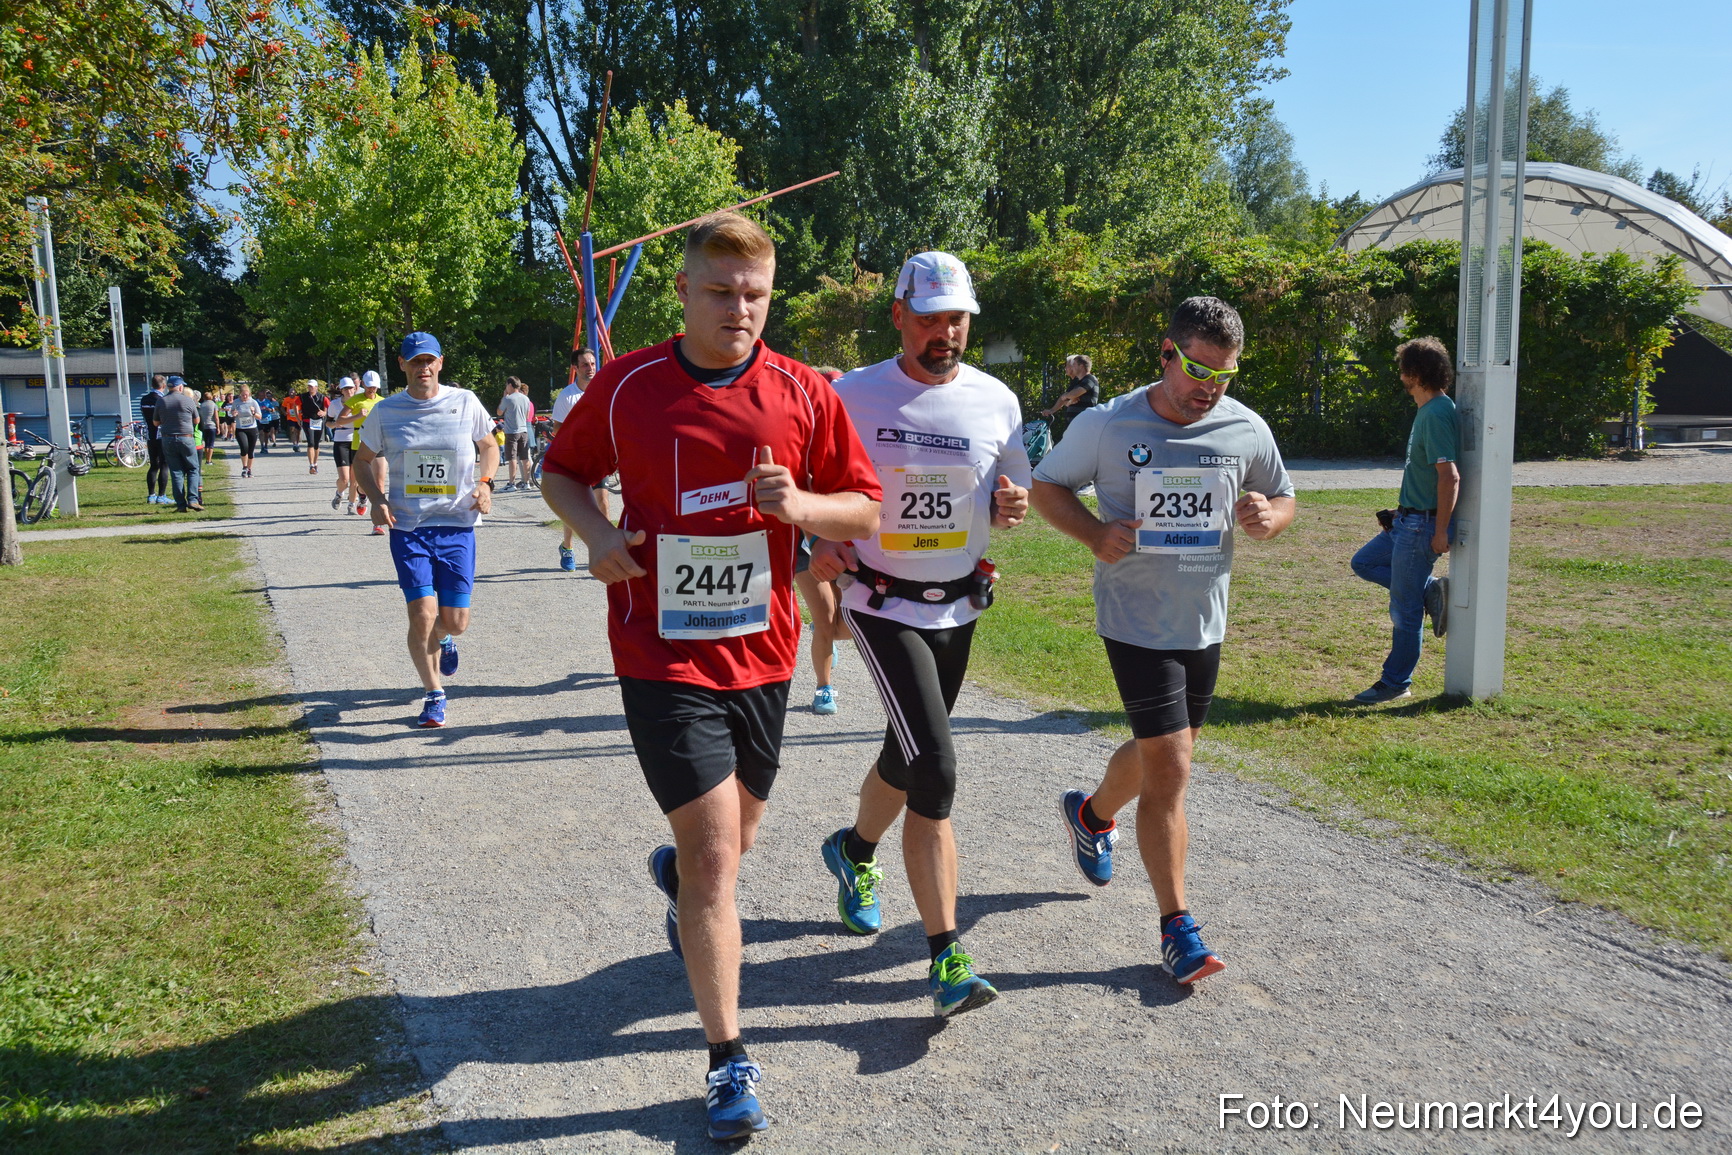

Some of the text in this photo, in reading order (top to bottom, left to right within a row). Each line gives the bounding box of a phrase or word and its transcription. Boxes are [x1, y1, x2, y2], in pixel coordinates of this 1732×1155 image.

[80, 378, 107, 386] KIOSK
[904, 432, 967, 449] BÜSCHEL
[1199, 455, 1240, 467] BOCK
[417, 463, 445, 478] 175
[906, 474, 947, 484] BOCK
[1163, 475, 1202, 486] BOCK
[700, 490, 730, 504] DEHN
[900, 491, 952, 520] 235
[1149, 492, 1213, 519] 2334
[913, 536, 939, 548] Jens
[1164, 533, 1199, 545] Adrian
[691, 545, 739, 557] BOCK
[1177, 563, 1219, 574] Stadtlauf
[675, 562, 754, 596] 2447
[684, 613, 747, 627] Johannes
